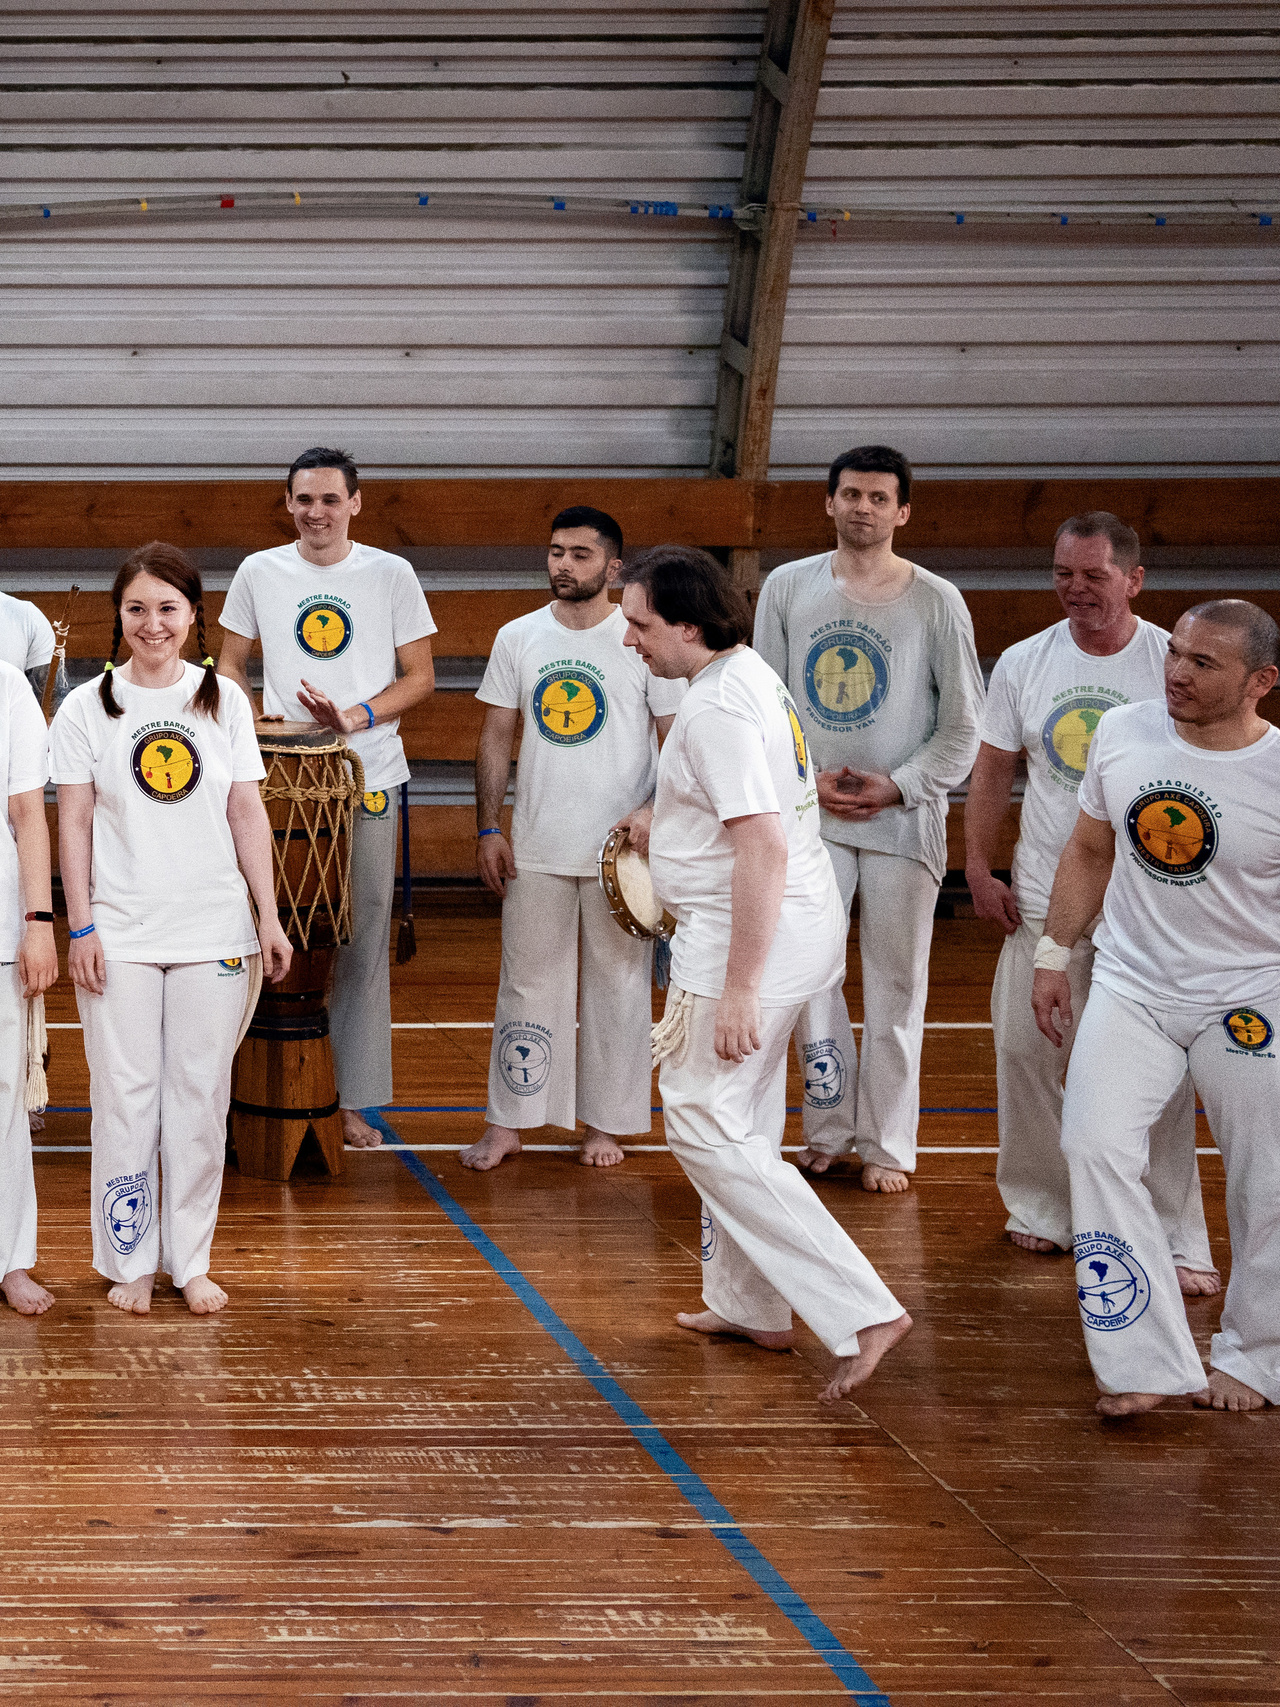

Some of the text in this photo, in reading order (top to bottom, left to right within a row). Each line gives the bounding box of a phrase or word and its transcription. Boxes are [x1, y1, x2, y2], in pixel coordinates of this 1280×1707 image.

[297, 594, 323, 609] MESTRE
[810, 620, 892, 653] MESTRE BARRÃO
[820, 635, 857, 650] GRUPO
[538, 659, 606, 681] MESTRE BARRÃO
[546, 671, 578, 684] GRUPO
[1052, 686, 1094, 703] MESTRE
[805, 706, 876, 732] PROFESSOR YAN
[131, 720, 196, 740] MESTRE BARRÃO
[144, 732, 169, 745] GRUPO
[544, 730, 586, 743] CAPOEIRA
[151, 788, 188, 801] CAPOEIRA
[1139, 780, 1223, 818] CASAQUISTÃO
[1134, 793, 1161, 811] GRUPO
[1184, 797, 1212, 834] CAPOEIRA
[1136, 843, 1165, 870] MESTRE
[1129, 851, 1169, 884] PROFESSOR
[499, 1021, 522, 1036] MESTRE
[106, 1175, 134, 1188] MESTRE
[1094, 1230, 1134, 1253] BARRÃO
[1074, 1243, 1124, 1260] GRUPO AXÉ
[1087, 1314, 1130, 1328] CAPOEIRA
